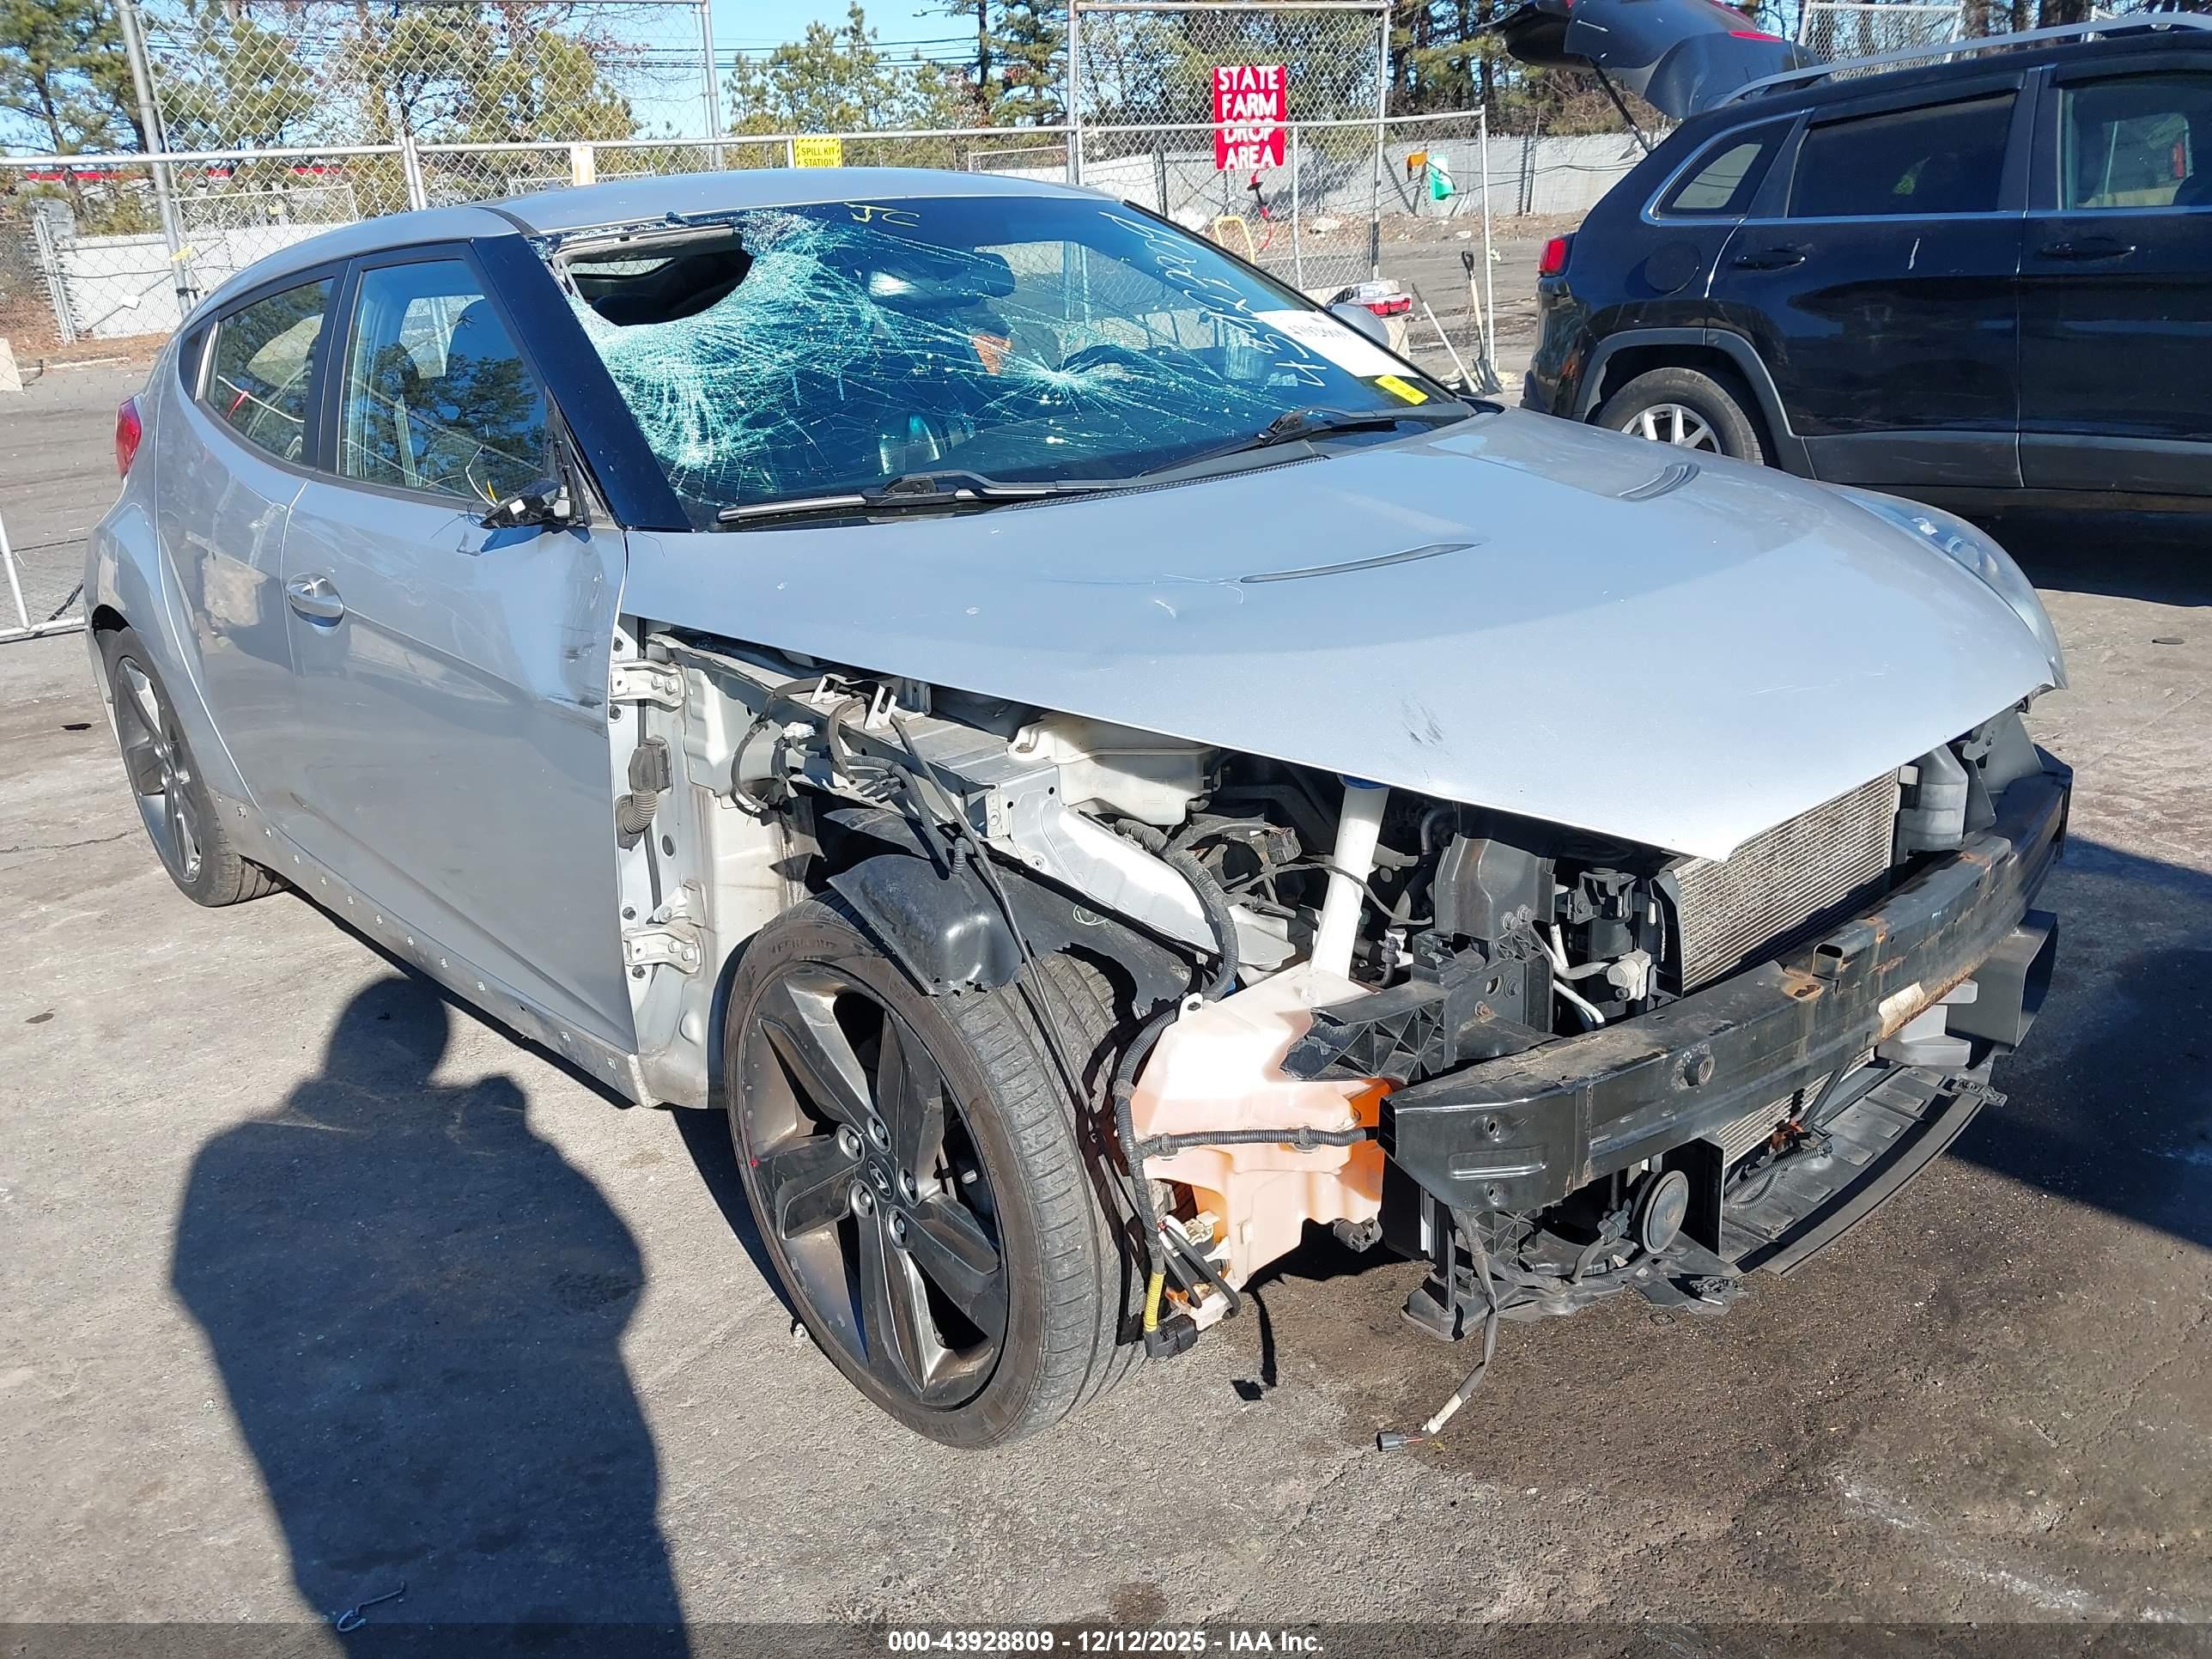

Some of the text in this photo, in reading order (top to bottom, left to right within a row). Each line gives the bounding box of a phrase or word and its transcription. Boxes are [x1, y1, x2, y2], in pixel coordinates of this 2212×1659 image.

[1218, 65, 1279, 91] STATE
[1222, 92, 1277, 118] FARM
[1223, 118, 1276, 144] DROP
[801, 147, 836, 156] SPILL KIT
[804, 159, 835, 168] STATION
[1224, 144, 1277, 170] AREA
